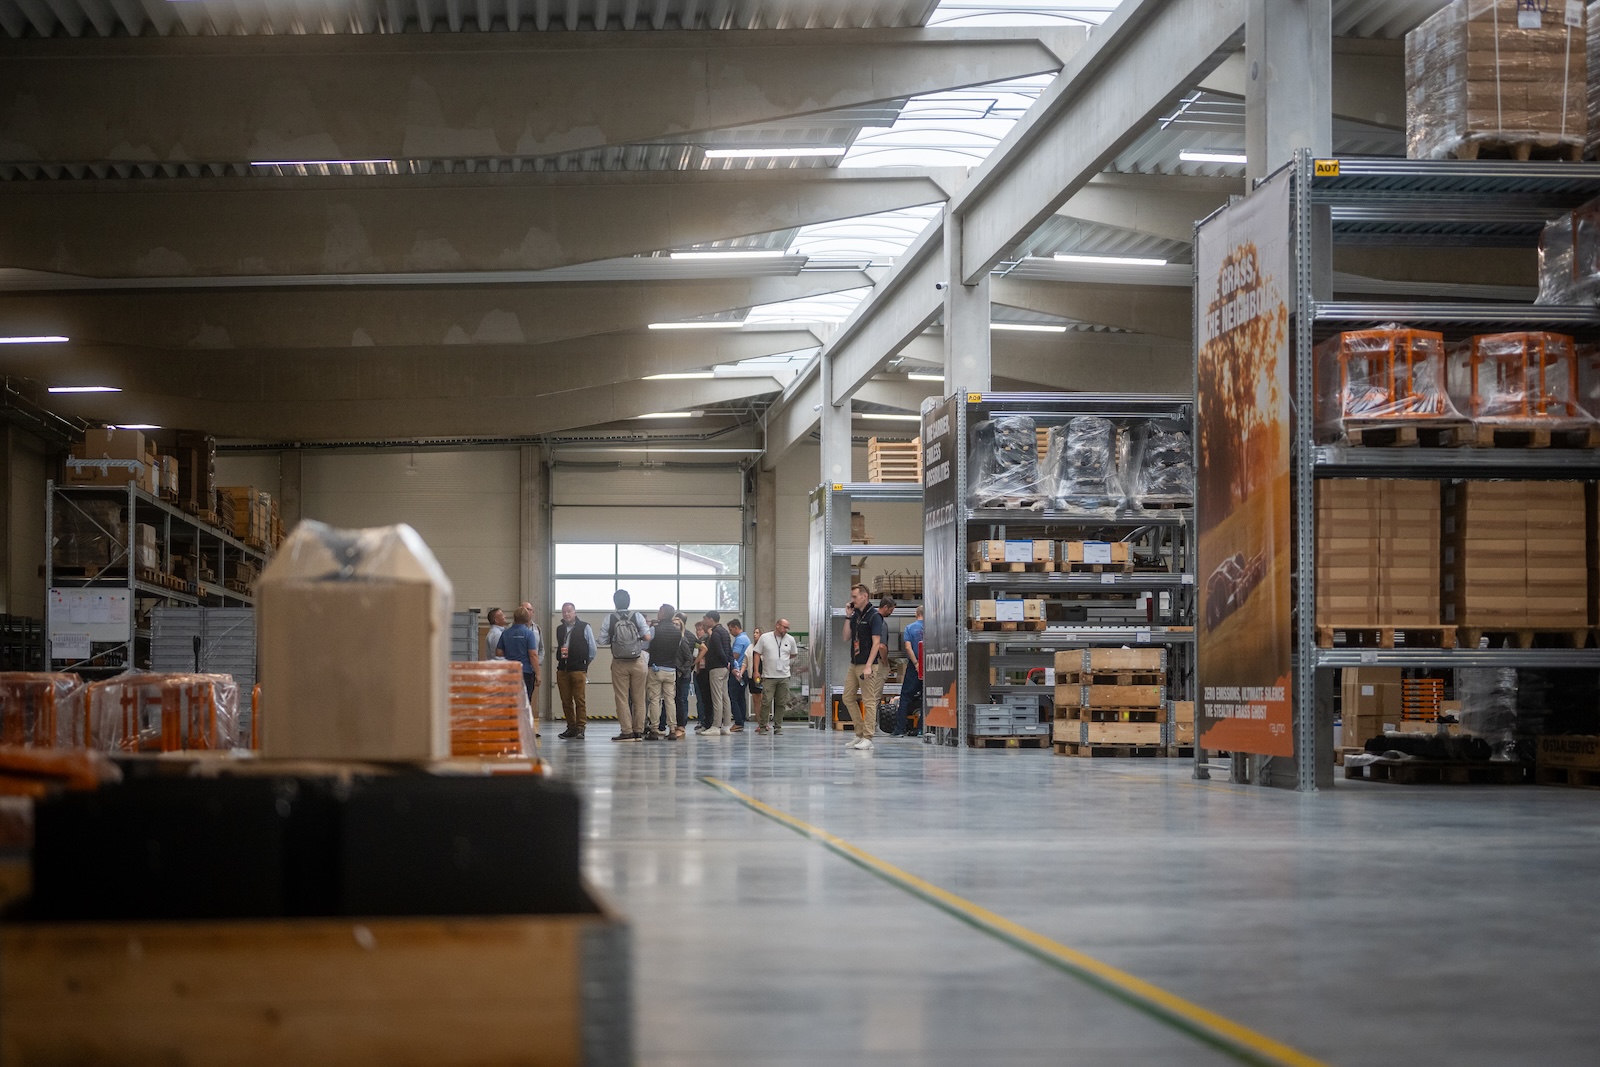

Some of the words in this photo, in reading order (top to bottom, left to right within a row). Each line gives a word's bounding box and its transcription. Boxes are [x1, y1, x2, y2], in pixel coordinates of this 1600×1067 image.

[1317, 164, 1338, 172] A07
[1221, 254, 1256, 296] GRASS,
[1205, 309, 1220, 341] THE
[1222, 276, 1282, 333] NEIGHBOURS
[1204, 687, 1215, 700] ZERO
[1216, 687, 1241, 703] EMISSIONS,
[1242, 687, 1264, 701] ULTIMATE
[1264, 687, 1285, 701] SILENCE
[1204, 704, 1214, 718] THE
[1214, 704, 1234, 718] STEALTHY
[1235, 705, 1250, 718] GRASS
